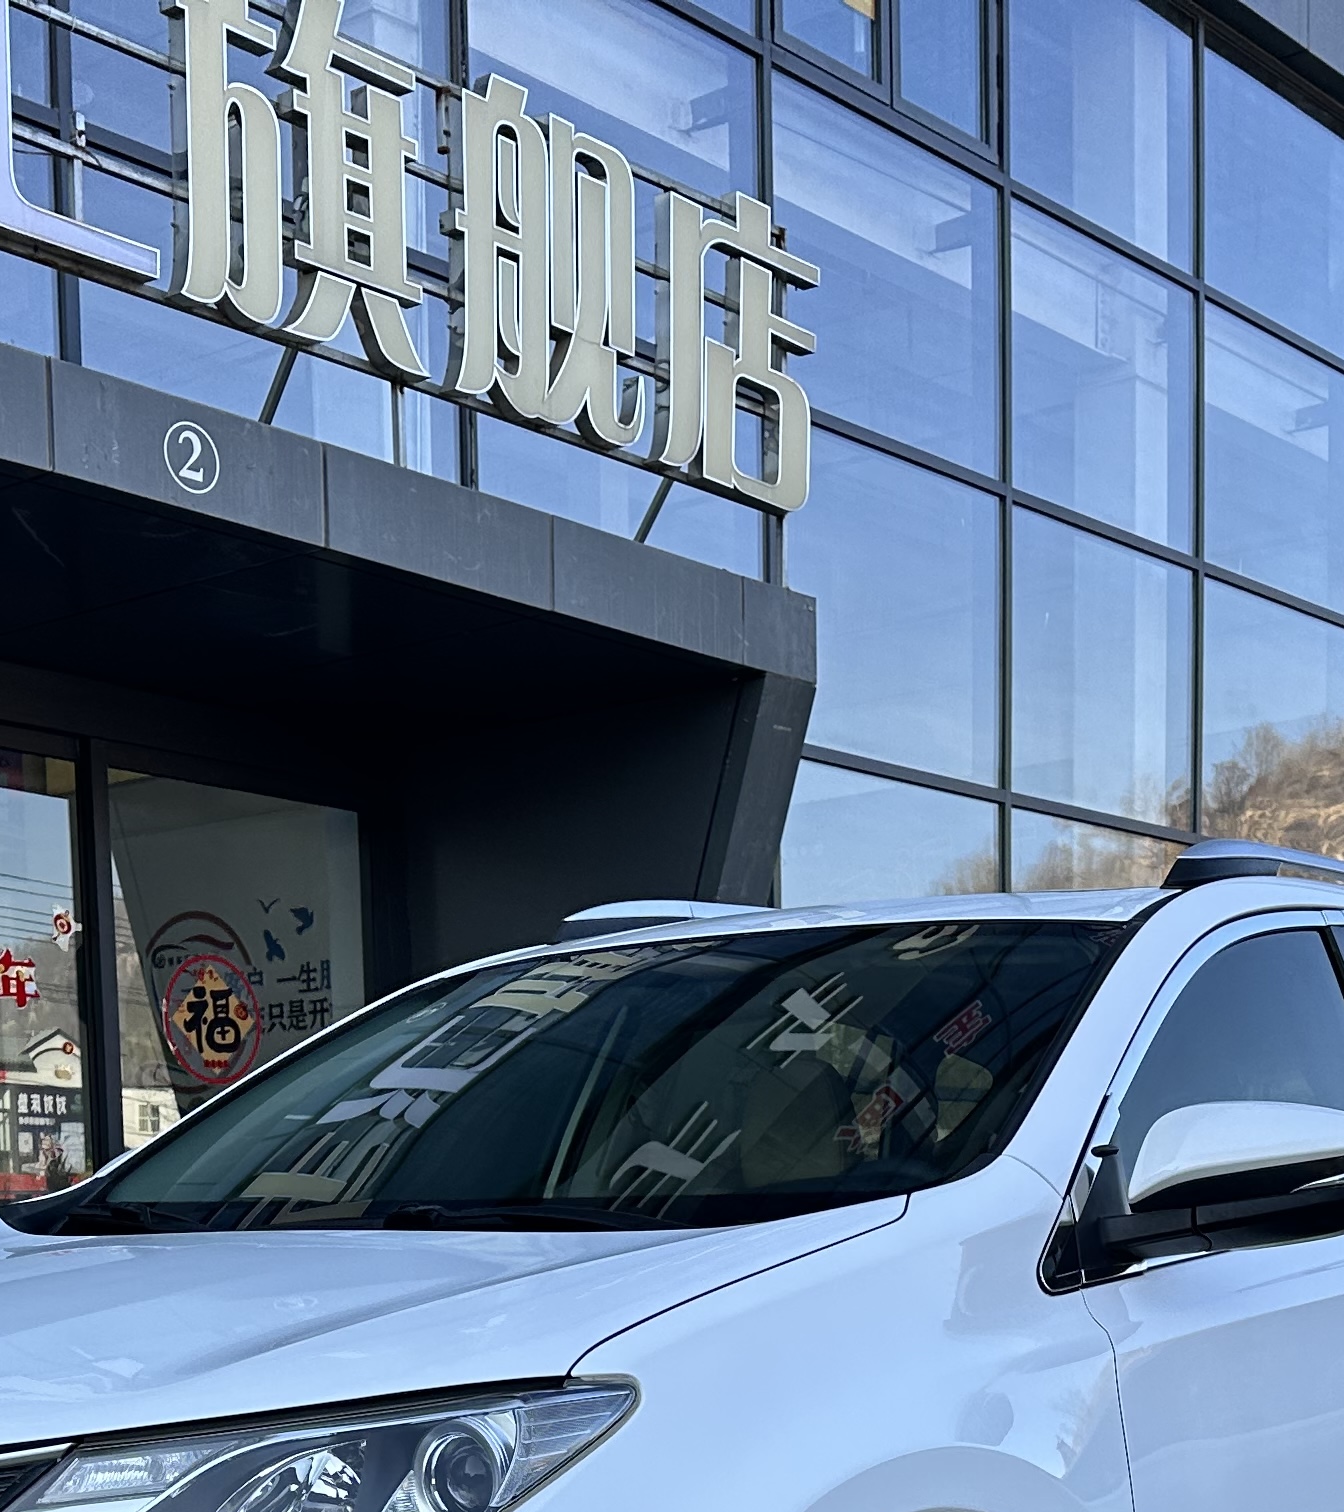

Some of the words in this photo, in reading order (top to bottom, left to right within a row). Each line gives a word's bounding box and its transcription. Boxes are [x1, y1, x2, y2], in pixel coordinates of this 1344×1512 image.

[183, 986, 241, 1054] 福
[258, 997, 333, 1034] 只是开
